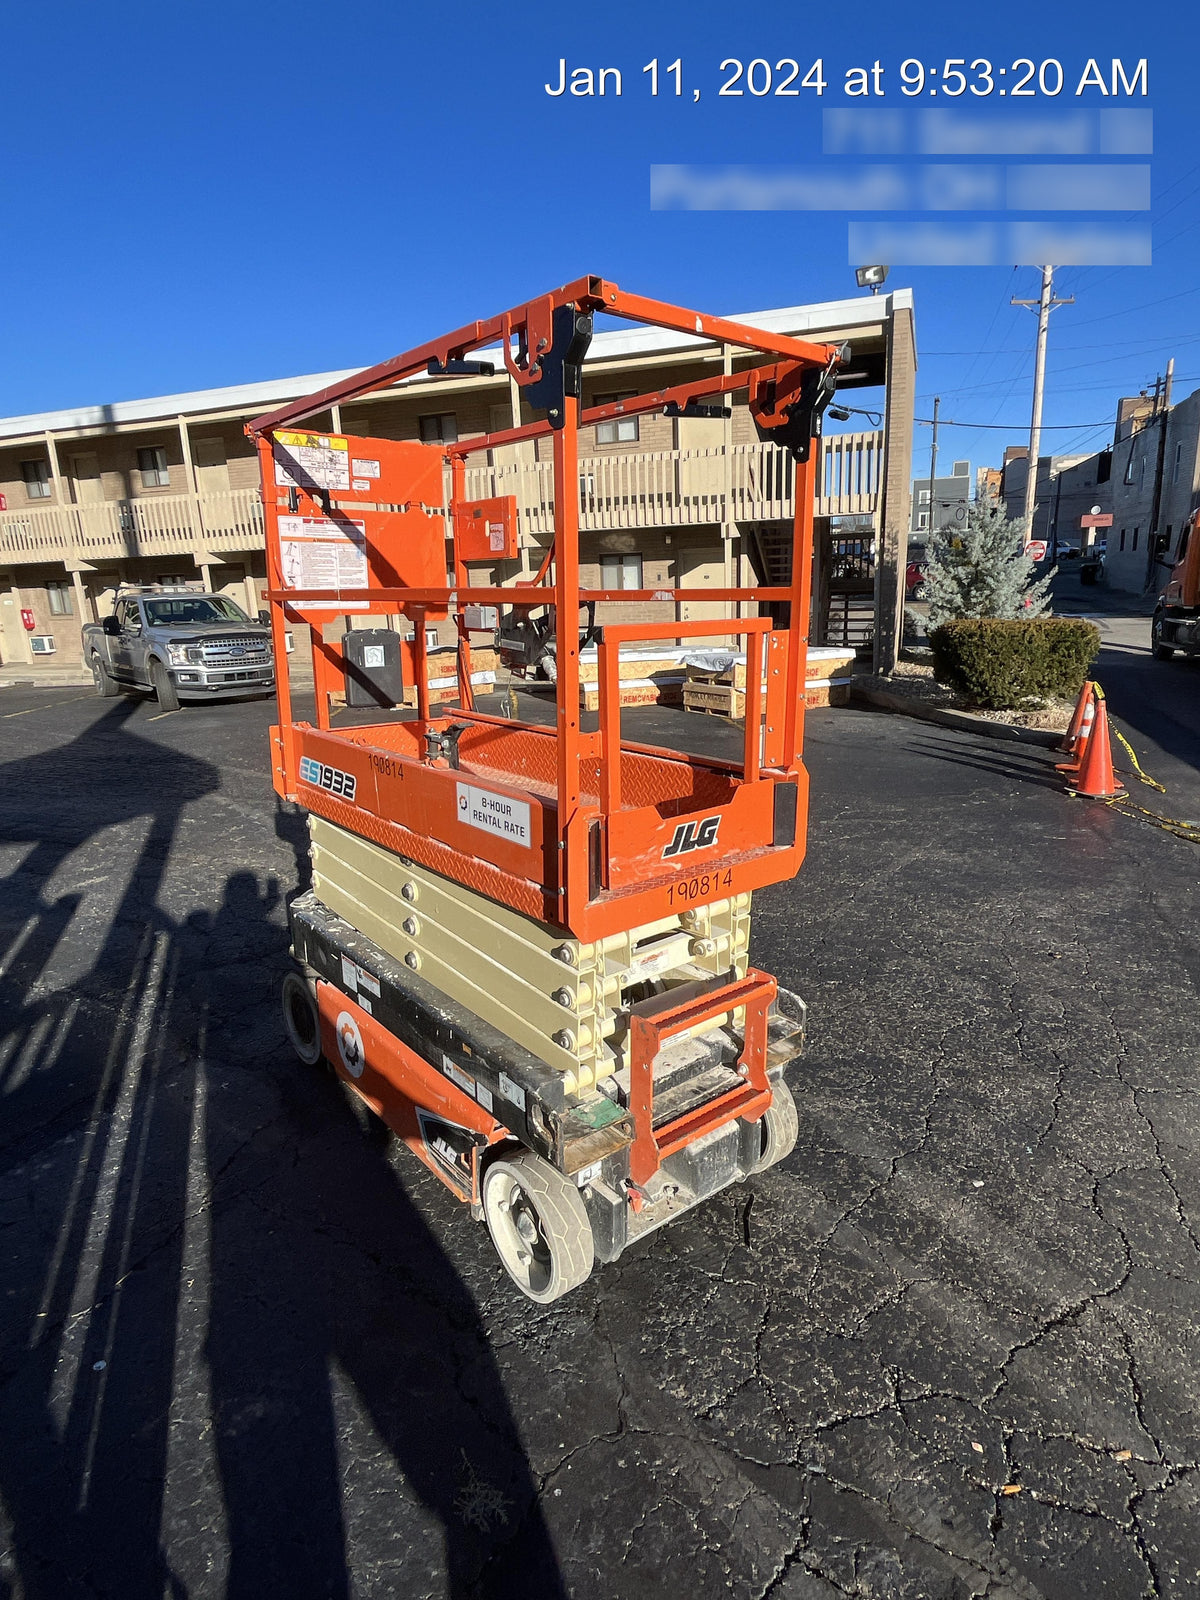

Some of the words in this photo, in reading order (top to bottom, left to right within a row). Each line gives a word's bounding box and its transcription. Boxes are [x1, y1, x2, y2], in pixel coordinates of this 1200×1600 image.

[623, 693, 662, 704] REMOVAB
[300, 757, 355, 799] ES1932
[368, 753, 404, 781] 190814
[481, 797, 512, 817] 8-HOUR
[473, 809, 501, 829] RENTAL
[503, 820, 525, 838] RATE
[662, 815, 721, 858] JLG
[666, 868, 733, 905] 190814
